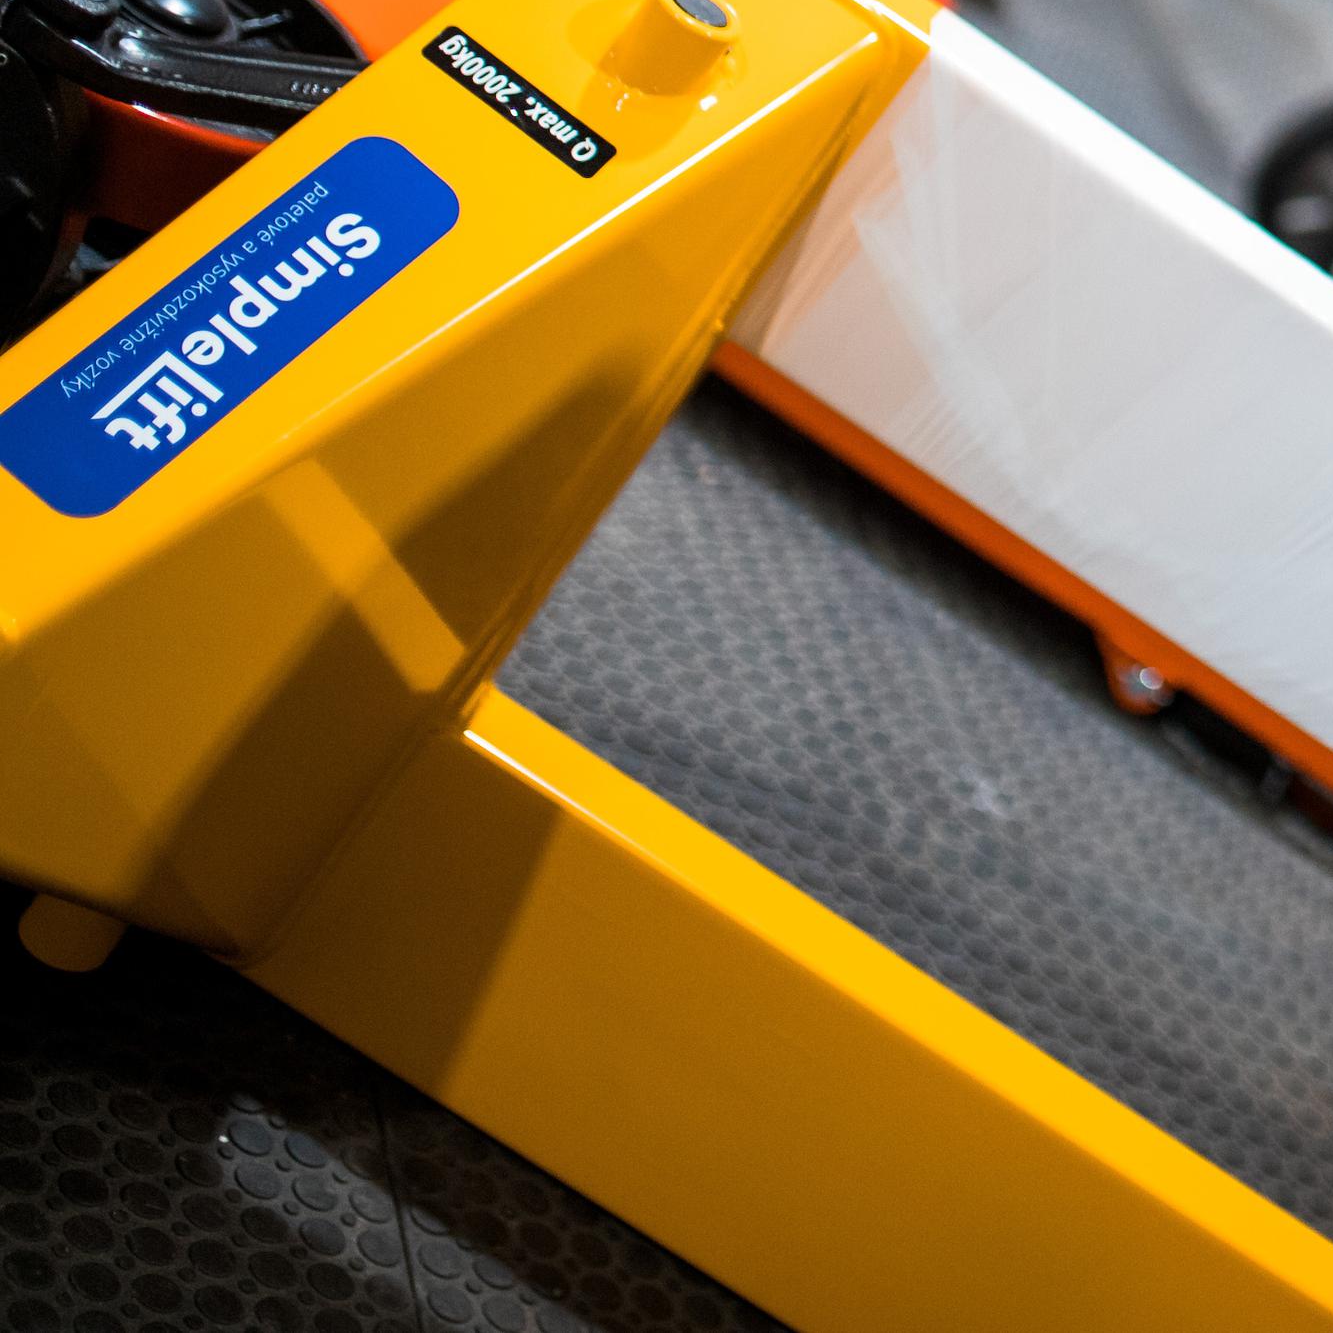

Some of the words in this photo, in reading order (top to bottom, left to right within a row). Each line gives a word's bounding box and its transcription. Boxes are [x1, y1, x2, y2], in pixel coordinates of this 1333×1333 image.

[438, 34, 523, 104] 2000kg
[524, 96, 579, 144] max.
[571, 137, 598, 163] Q
[256, 181, 329, 246] paletové
[242, 240, 258, 255] a
[119, 253, 245, 356] vysokozdvižné
[60, 350, 122, 399] vozíky
